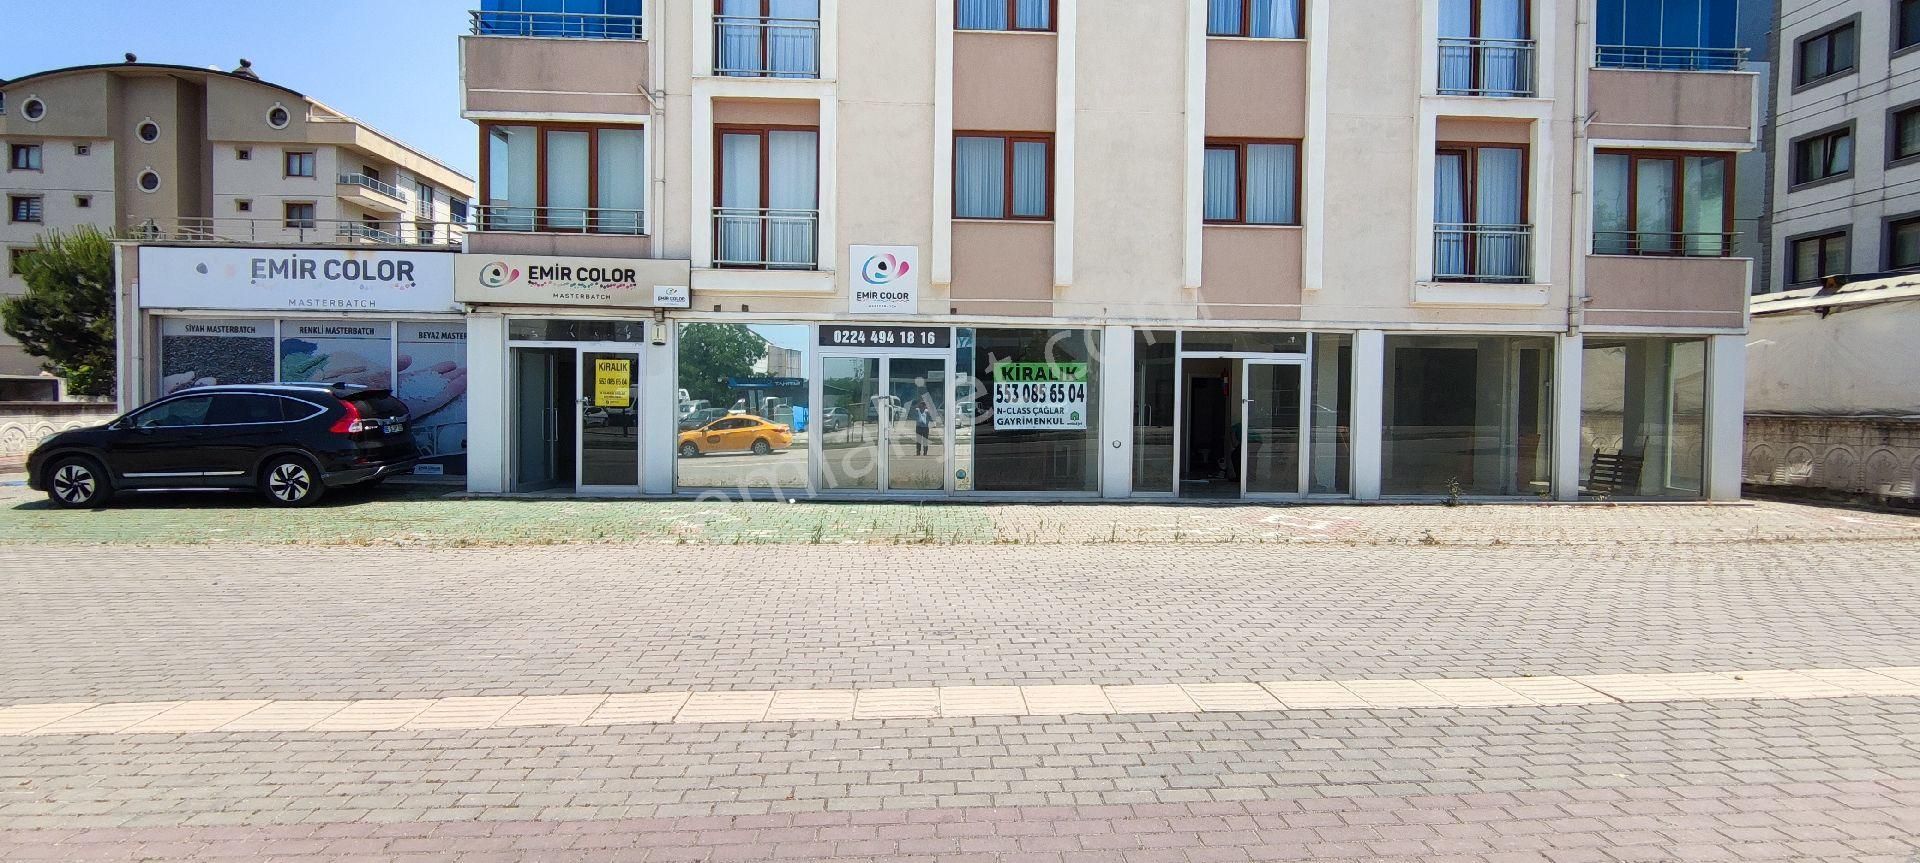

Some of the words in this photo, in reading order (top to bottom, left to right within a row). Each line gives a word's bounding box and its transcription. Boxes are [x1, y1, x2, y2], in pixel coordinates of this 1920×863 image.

[251, 253, 317, 280] EMİR
[324, 259, 416, 281] COLOR
[528, 263, 572, 281] EMİR
[577, 268, 636, 283] COLOR
[553, 293, 611, 301] MASTERBATCH
[856, 290, 878, 299] EMİR
[879, 292, 909, 300] COLOR
[288, 299, 377, 308] MASTERBATCH
[185, 324, 205, 333] SİYAH
[207, 325, 256, 334] MASTERBATCH
[299, 325, 323, 334] RENKLİ
[325, 327, 375, 335] MASTERBATCH
[418, 331, 440, 340] BEYAZ
[833, 330, 866, 343] 0224
[870, 330, 895, 343] 494
[900, 331, 915, 344] 18
[920, 331, 936, 345] 16
[1001, 364, 1078, 381] KİRALIK
[996, 383, 1019, 403] 553
[1022, 383, 1046, 403] 085
[1049, 383, 1065, 403] 65
[1068, 383, 1085, 403] 04
[996, 407, 1031, 415] N-CLASS
[1032, 406, 1065, 416] ÇAĞLAR
[997, 417, 1065, 425] GAYRİMENKUL
